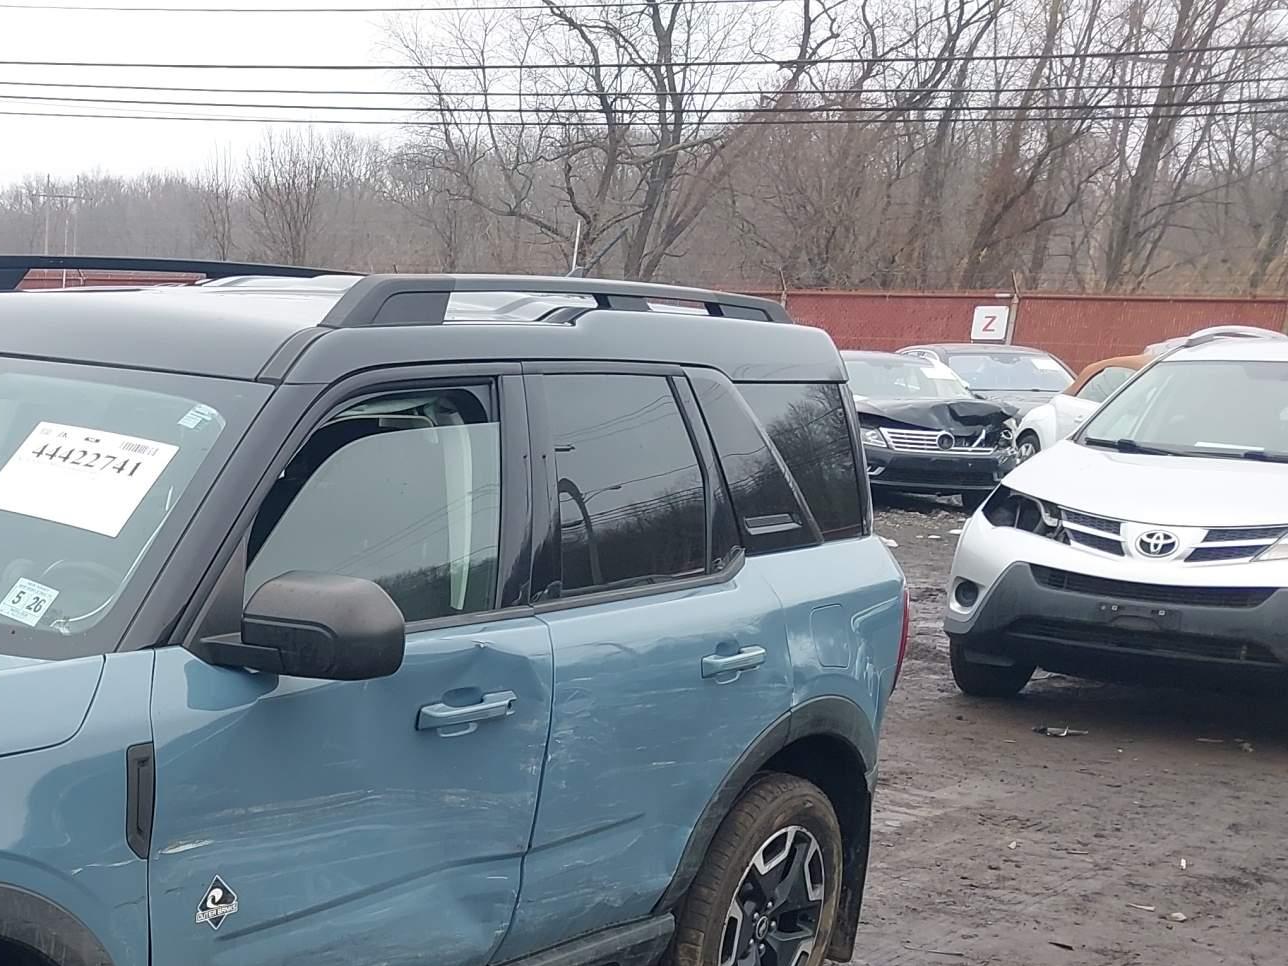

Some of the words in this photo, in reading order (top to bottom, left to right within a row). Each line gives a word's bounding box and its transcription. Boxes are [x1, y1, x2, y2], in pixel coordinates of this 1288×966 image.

[982, 315, 997, 332] Z
[32, 443, 143, 477] 44422741
[11, 590, 26, 605] 5
[25, 596, 47, 613] 26
